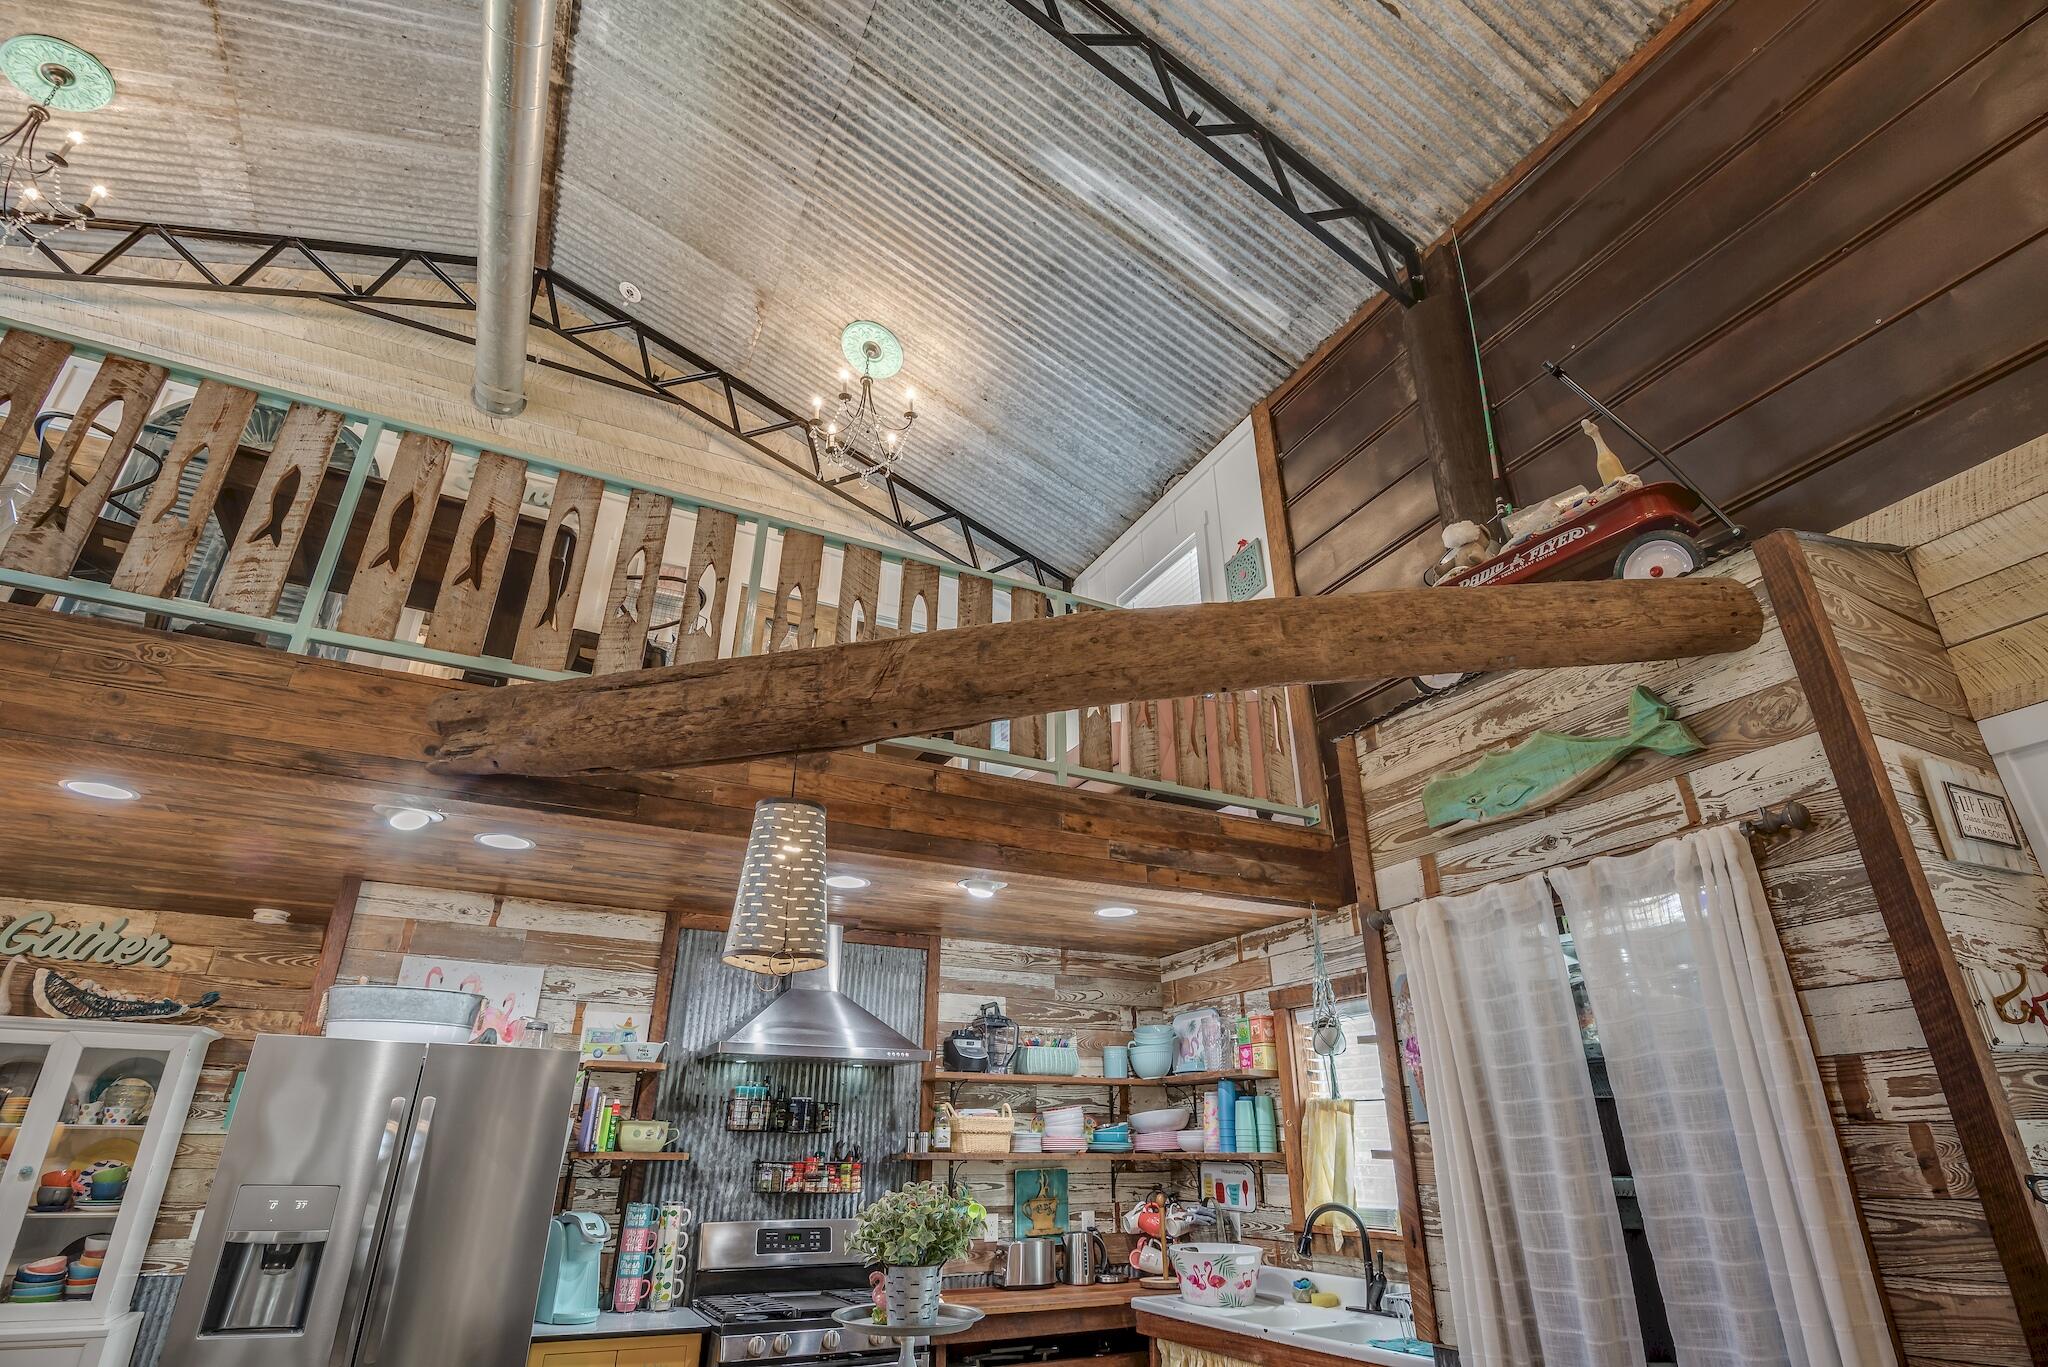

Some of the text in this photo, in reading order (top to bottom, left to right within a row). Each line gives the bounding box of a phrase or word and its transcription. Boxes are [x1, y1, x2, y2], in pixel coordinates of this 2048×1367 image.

[1528, 527, 1586, 562] FLYER
[1536, 550, 1558, 562] EDITION
[1951, 792, 1975, 813] FLIP
[1973, 827, 1988, 836] the
[1988, 830, 2014, 841] SOUTH
[0, 911, 172, 968] Gather
